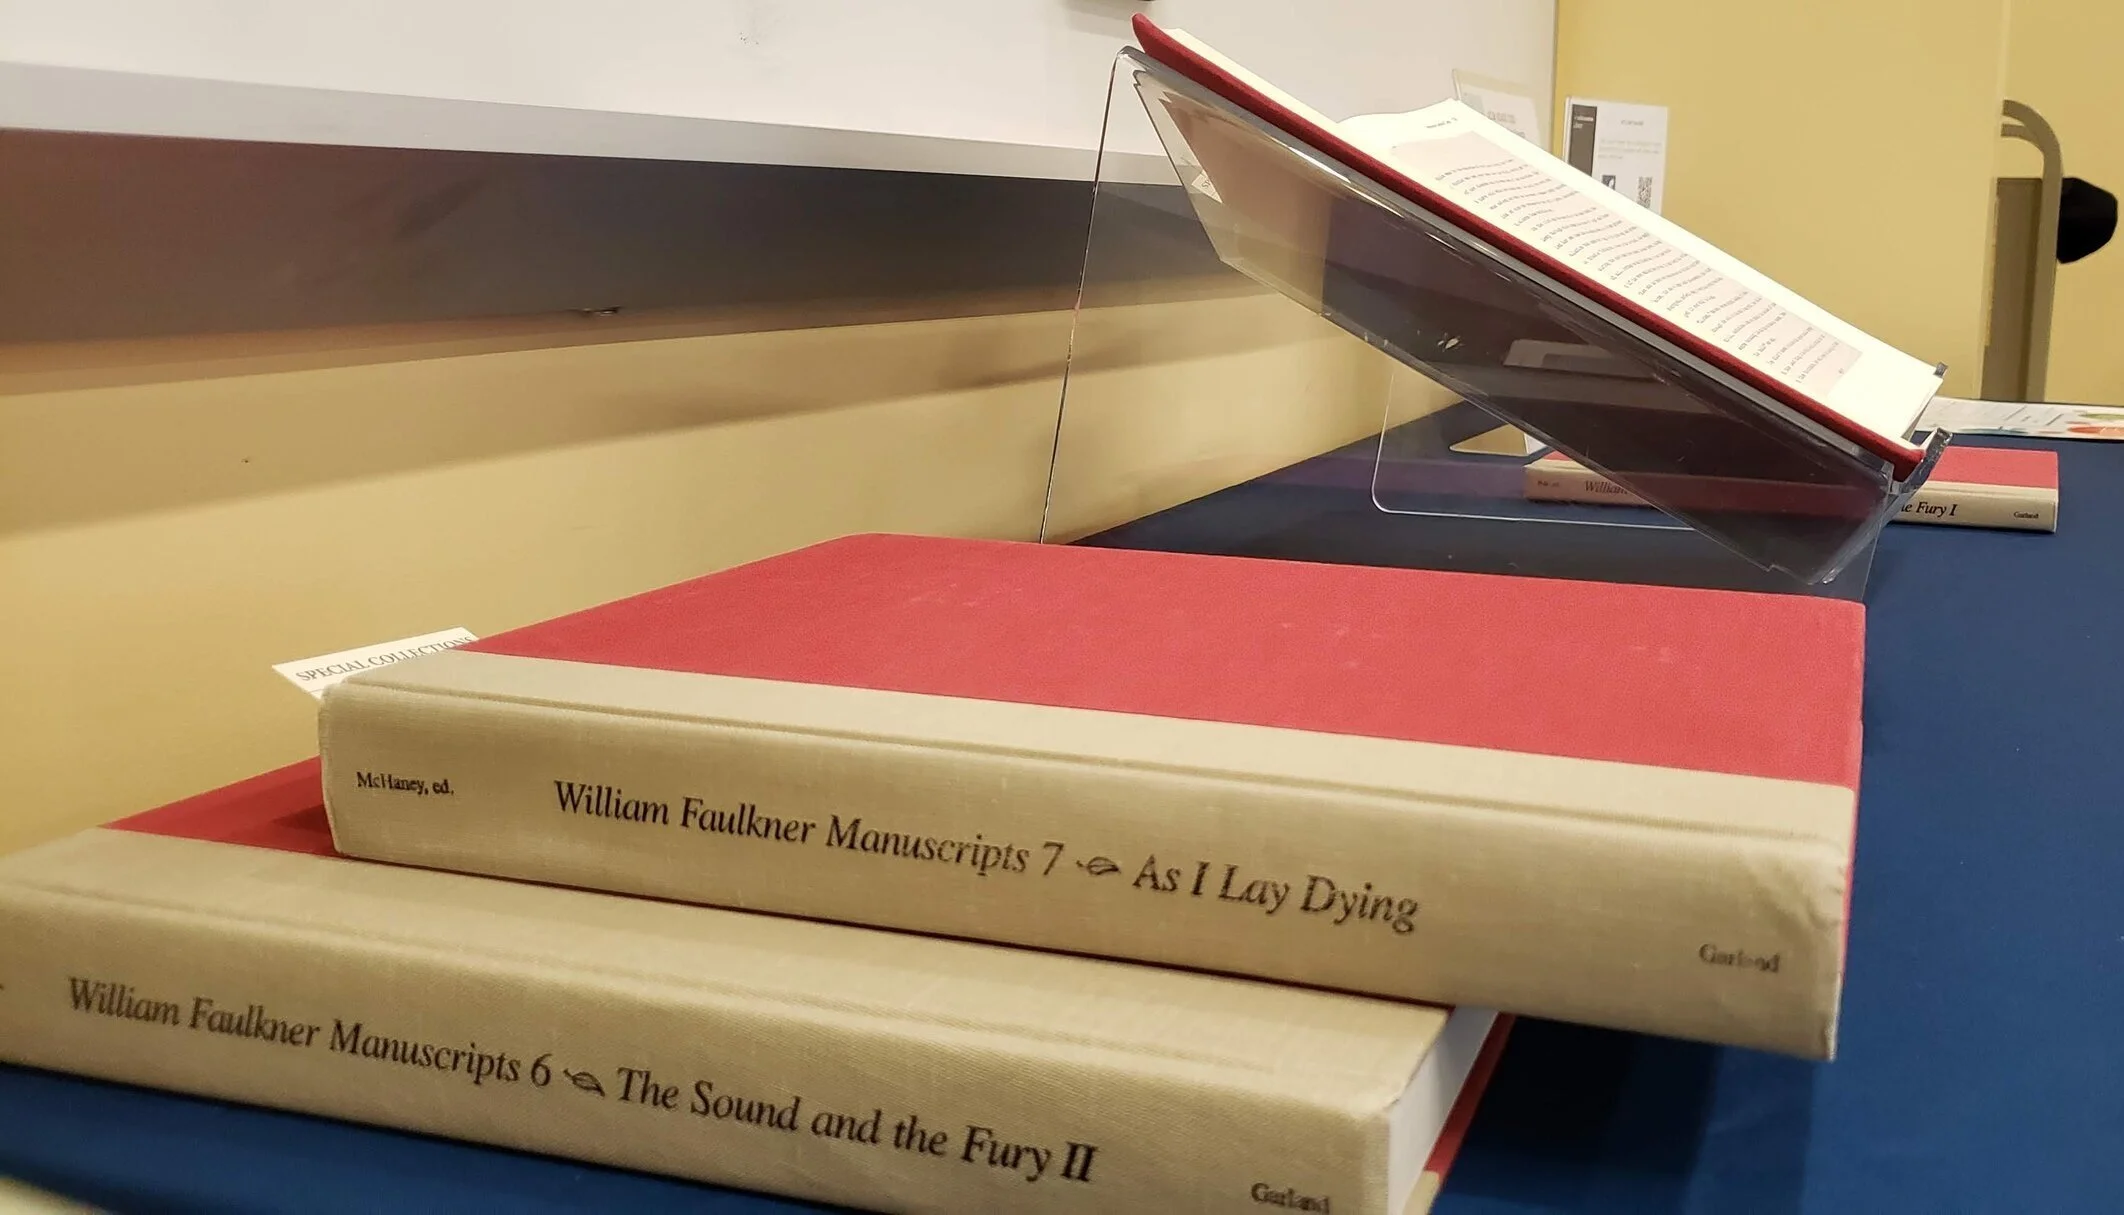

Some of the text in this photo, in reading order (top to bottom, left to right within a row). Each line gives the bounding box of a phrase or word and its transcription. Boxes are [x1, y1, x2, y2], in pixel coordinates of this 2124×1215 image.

[1916, 501, 1947, 518] Fury
[1949, 504, 1958, 516] I
[296, 659, 370, 682] SPECIAL
[356, 771, 455, 796] McHaney, ed.
[553, 779, 1420, 934] William Faulkner Manuscripts 7 As I Lay Dying
[67, 976, 1099, 1183] William Faulkner Manuscripts 6 The Sound and the Fury II
